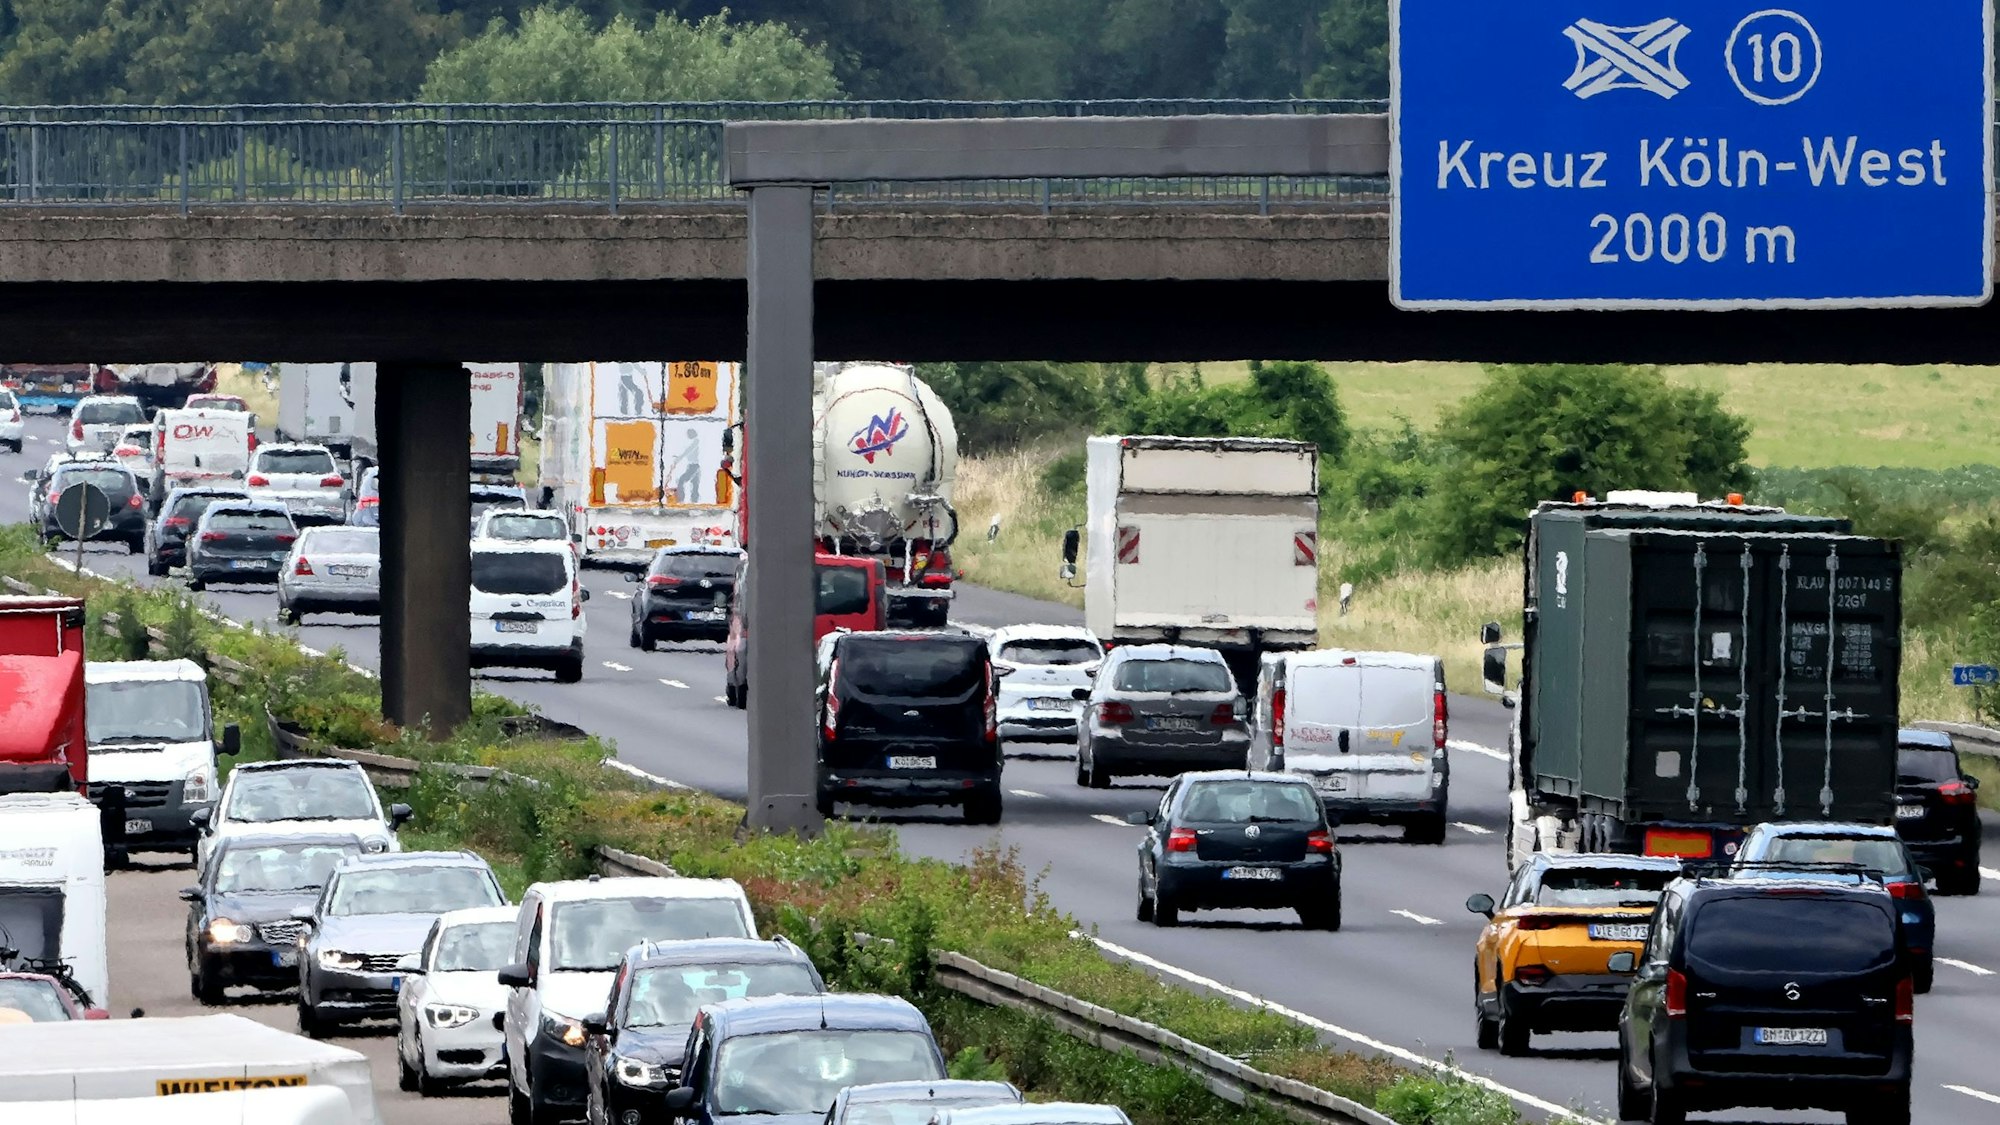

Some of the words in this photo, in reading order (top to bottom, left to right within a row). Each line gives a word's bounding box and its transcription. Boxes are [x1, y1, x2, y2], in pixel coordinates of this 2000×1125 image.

[1747, 32, 1802, 83] 10
[1437, 139, 1608, 189] Kreuz
[1639, 136, 1948, 188] Köln-West
[1588, 211, 1728, 264] 2000
[1745, 224, 1797, 264] m
